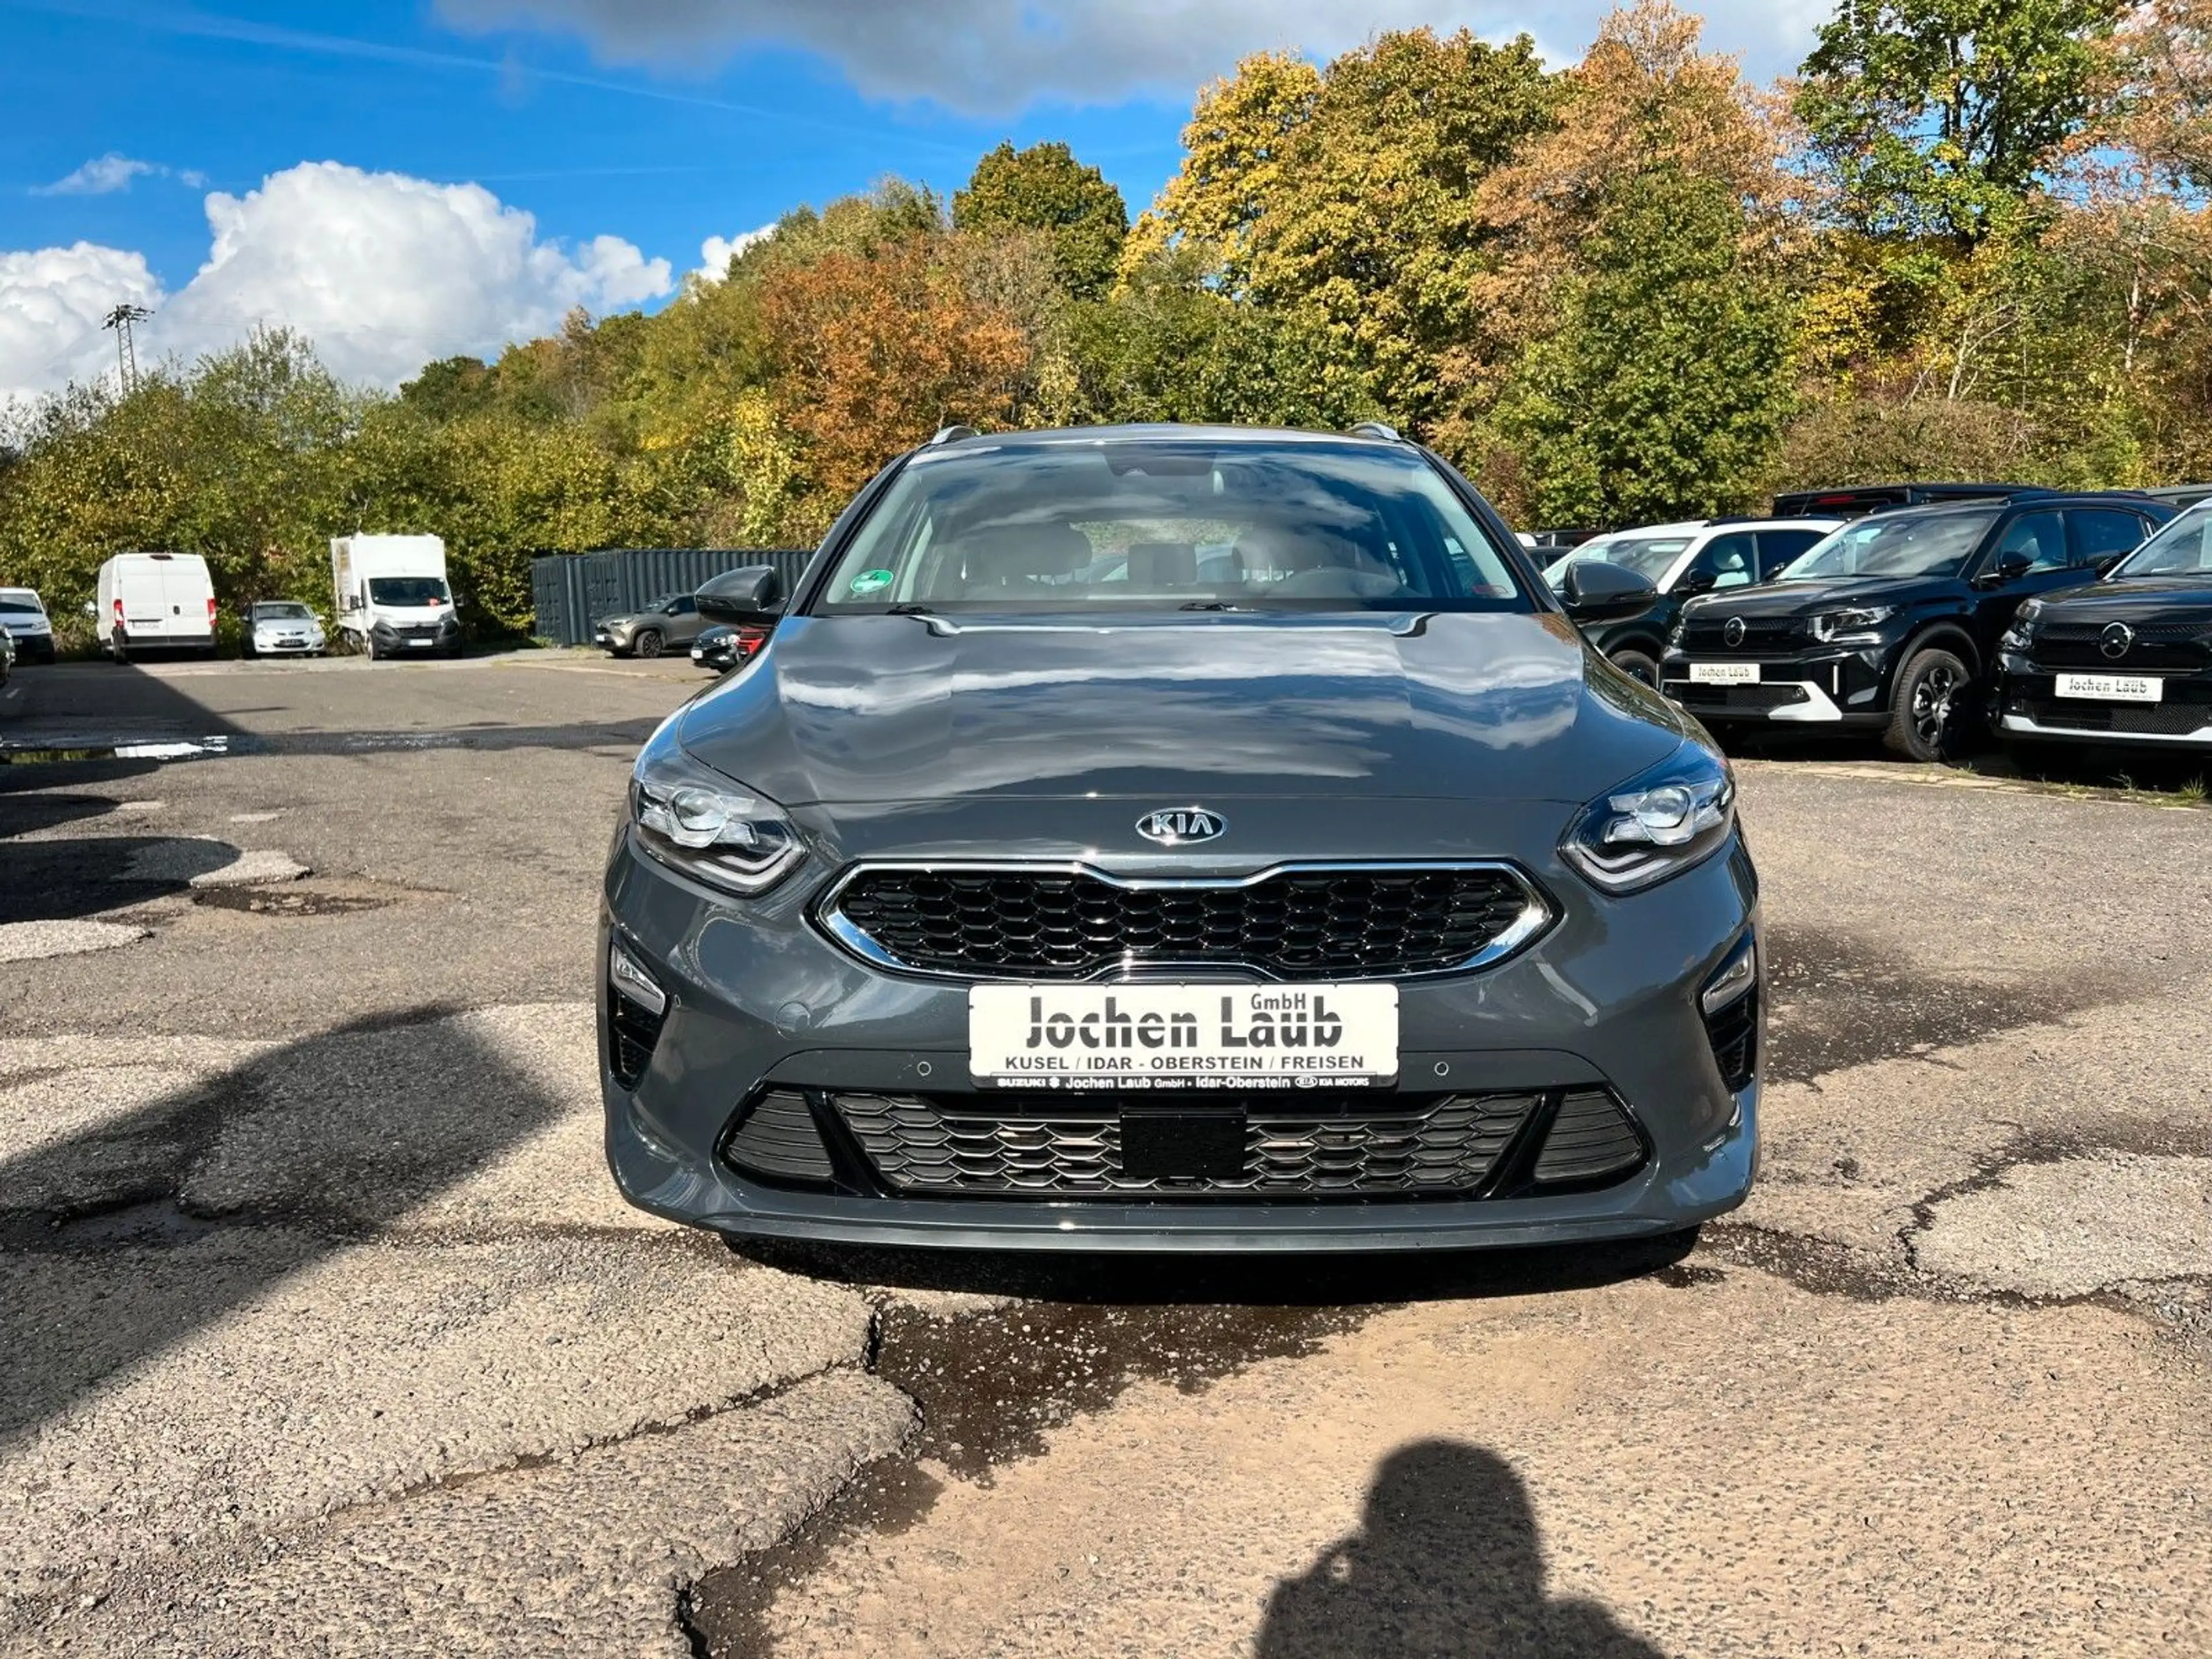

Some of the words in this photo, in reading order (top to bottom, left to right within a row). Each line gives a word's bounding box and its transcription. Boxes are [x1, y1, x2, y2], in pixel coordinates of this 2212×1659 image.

[1152, 814, 1214, 835] KIA
[1251, 993, 1306, 1010] GmbH
[1027, 997, 1197, 1048] Jochen
[1221, 995, 1342, 1048] Laub
[1005, 1056, 1070, 1070] KUSEL
[1087, 1056, 1132, 1070] IDAR
[1151, 1056, 1263, 1070] OBERSTEIN
[1281, 1056, 1364, 1069] FREISEN
[997, 1078, 1046, 1087] SUZUKI
[1066, 1077, 1115, 1089] Jochen
[1118, 1077, 1151, 1089] Laub
[1154, 1078, 1185, 1089] GmbH
[1195, 1077, 1291, 1089] Idar-Oberstein
